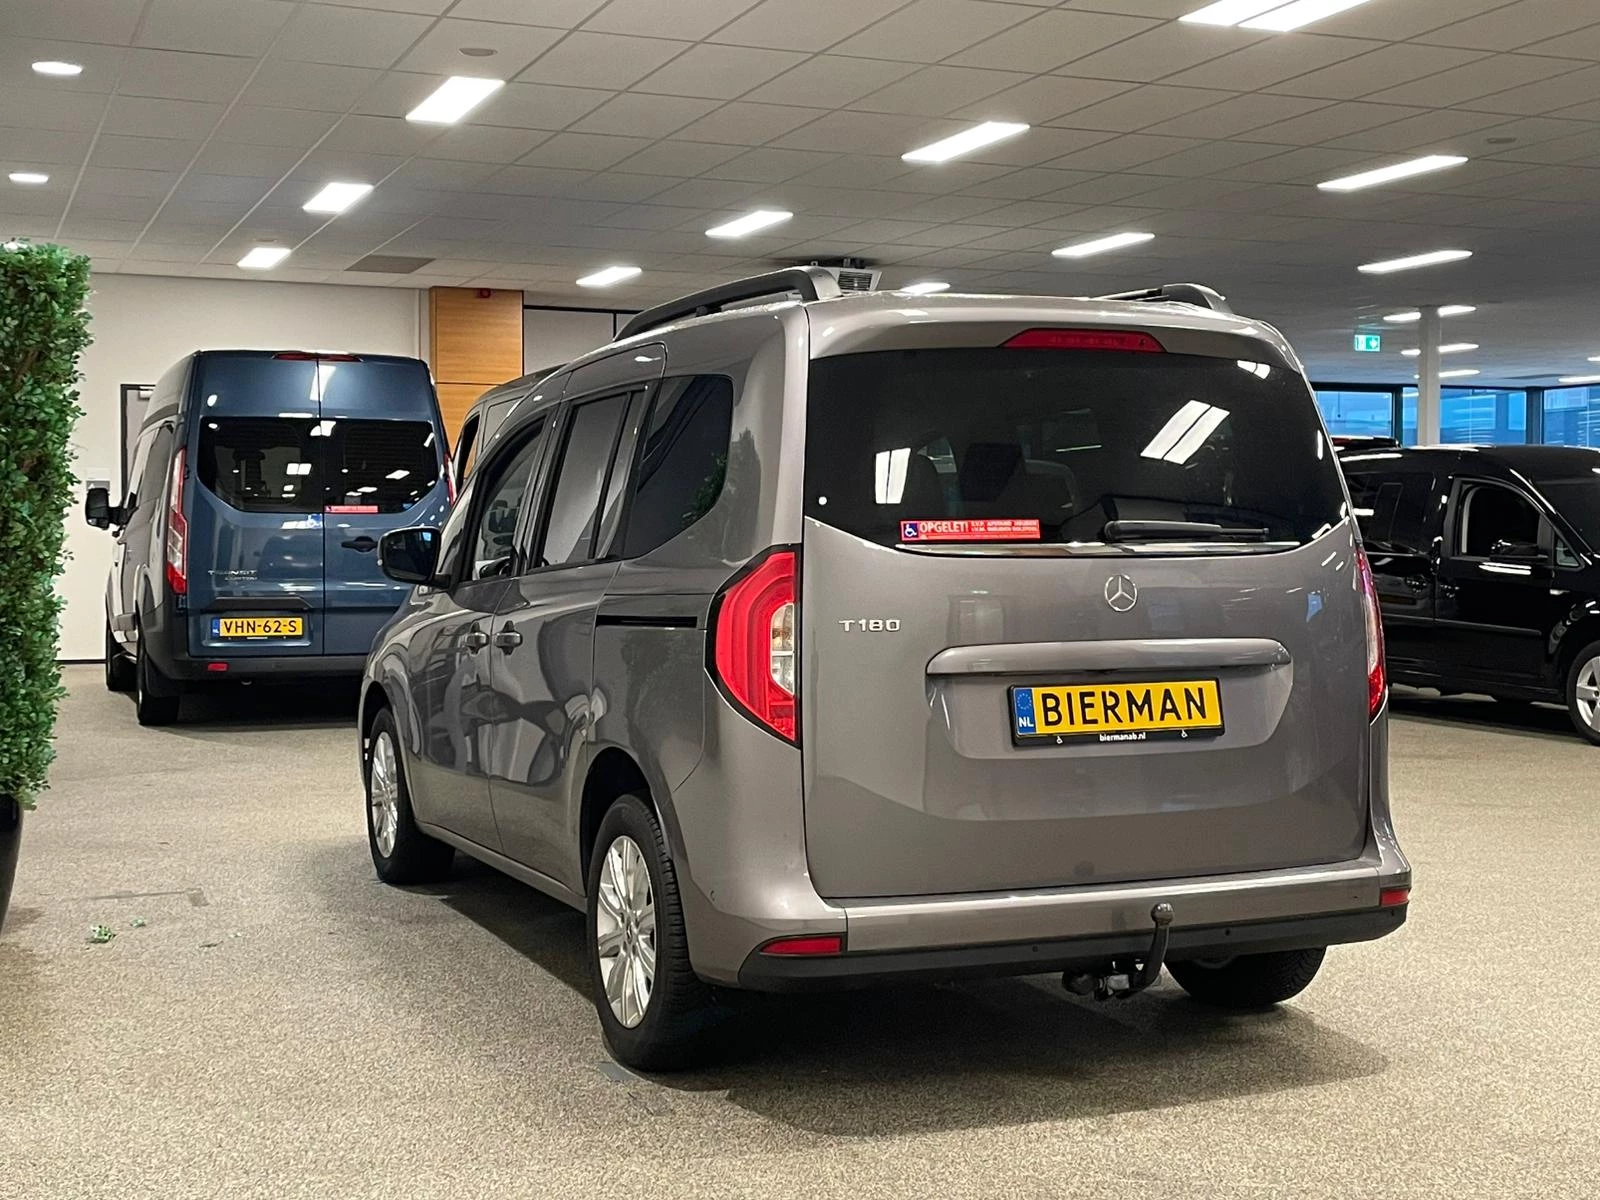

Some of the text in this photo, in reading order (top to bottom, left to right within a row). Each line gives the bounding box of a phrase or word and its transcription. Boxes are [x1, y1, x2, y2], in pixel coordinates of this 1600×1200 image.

[919, 520, 969, 533] OPGELET!
[223, 619, 297, 634] VHN-62-S
[1041, 687, 1207, 727] BIERMAN
[1018, 715, 1035, 728] NL
[1099, 731, 1147, 742] biermanab.nl
